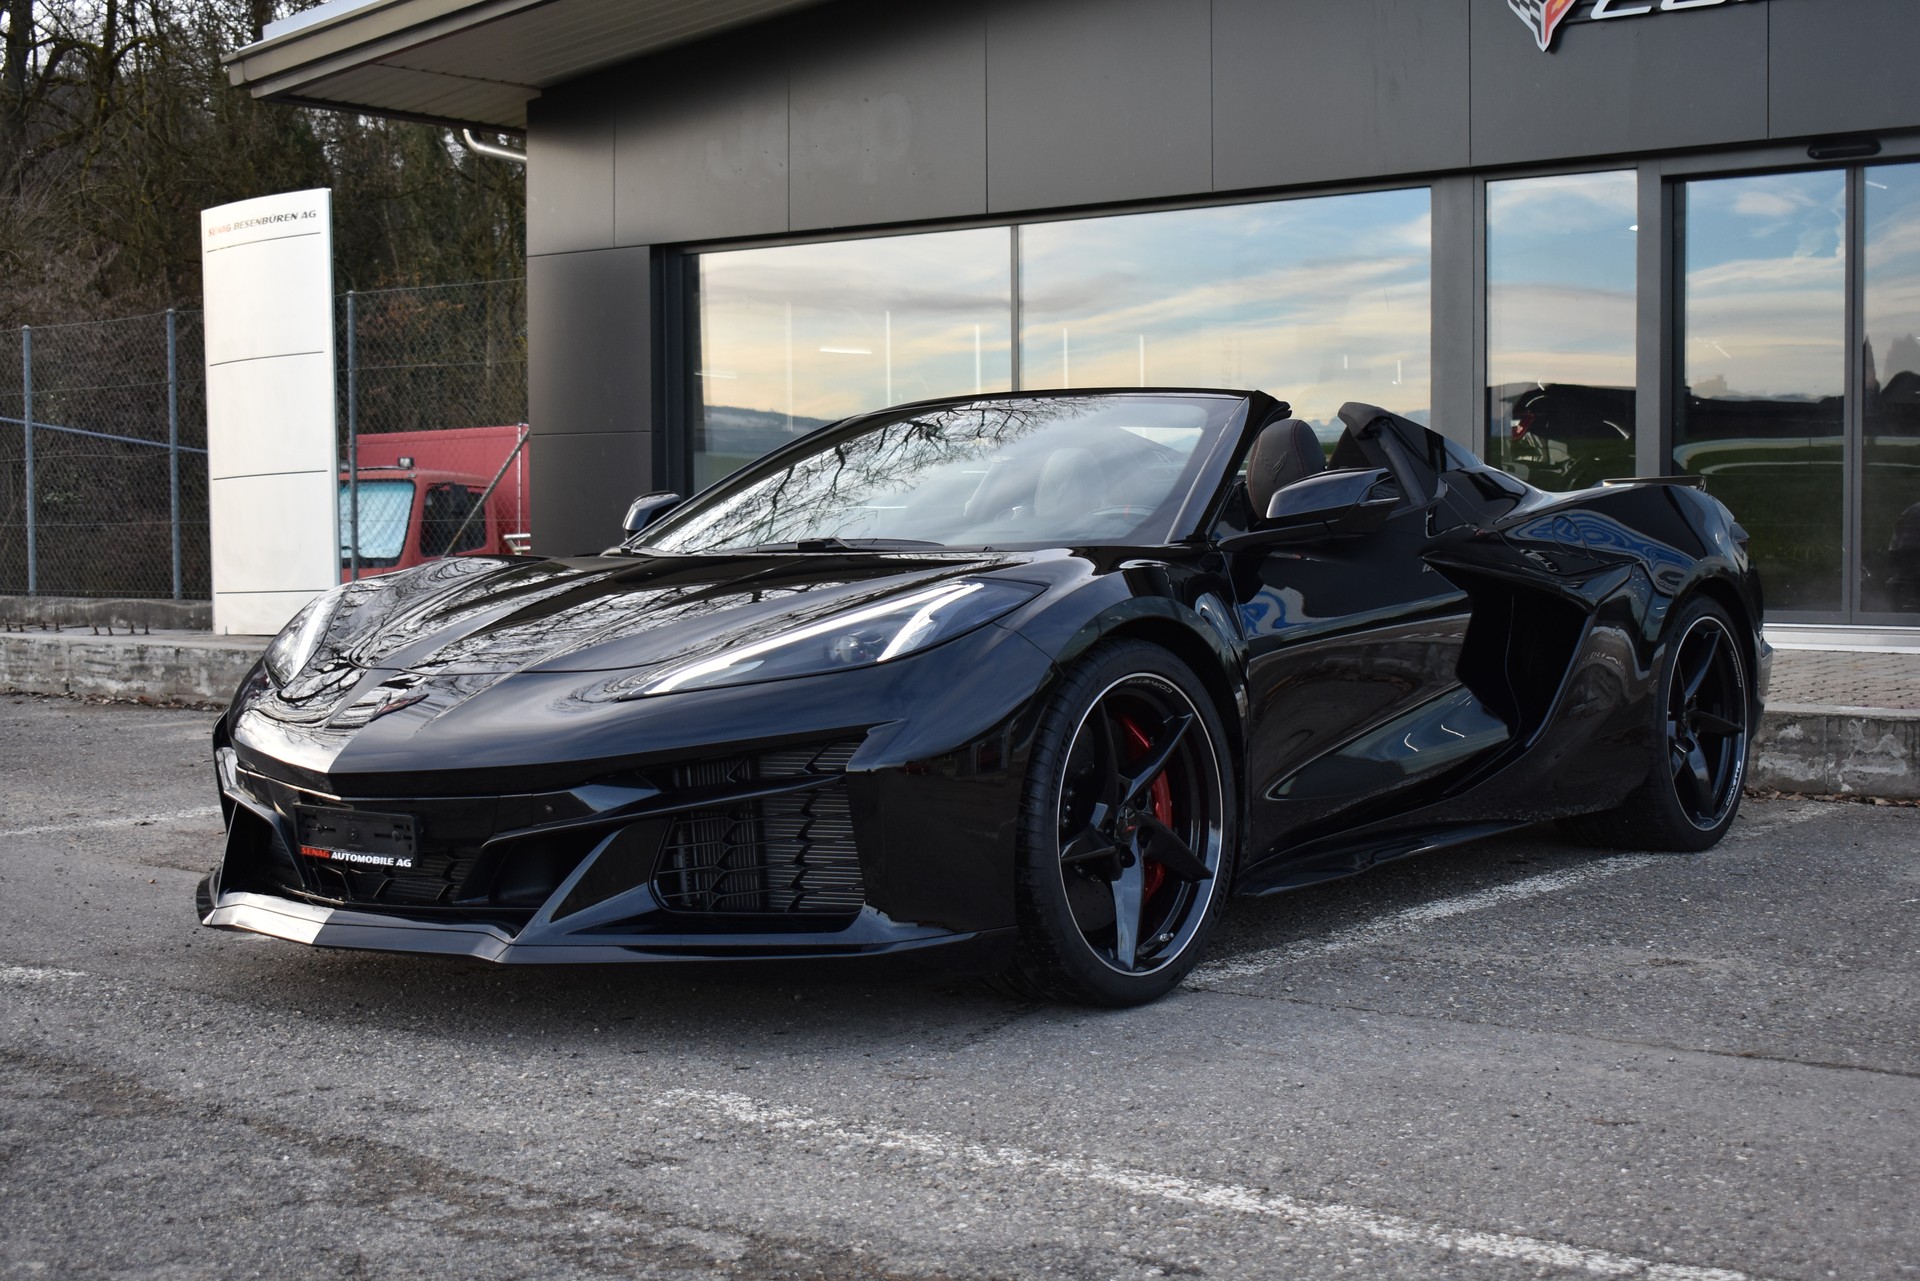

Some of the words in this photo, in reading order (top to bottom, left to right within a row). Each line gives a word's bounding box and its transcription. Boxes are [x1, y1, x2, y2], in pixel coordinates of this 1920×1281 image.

[234, 212, 298, 230] BESENBÜREN
[301, 210, 317, 219] AG
[1126, 679, 1172, 693] CORVETTE
[1725, 760, 1741, 806] CORVETTE
[301, 847, 329, 858] SENAG
[331, 852, 394, 866] AUTOMOBILE
[396, 859, 411, 867] AG
